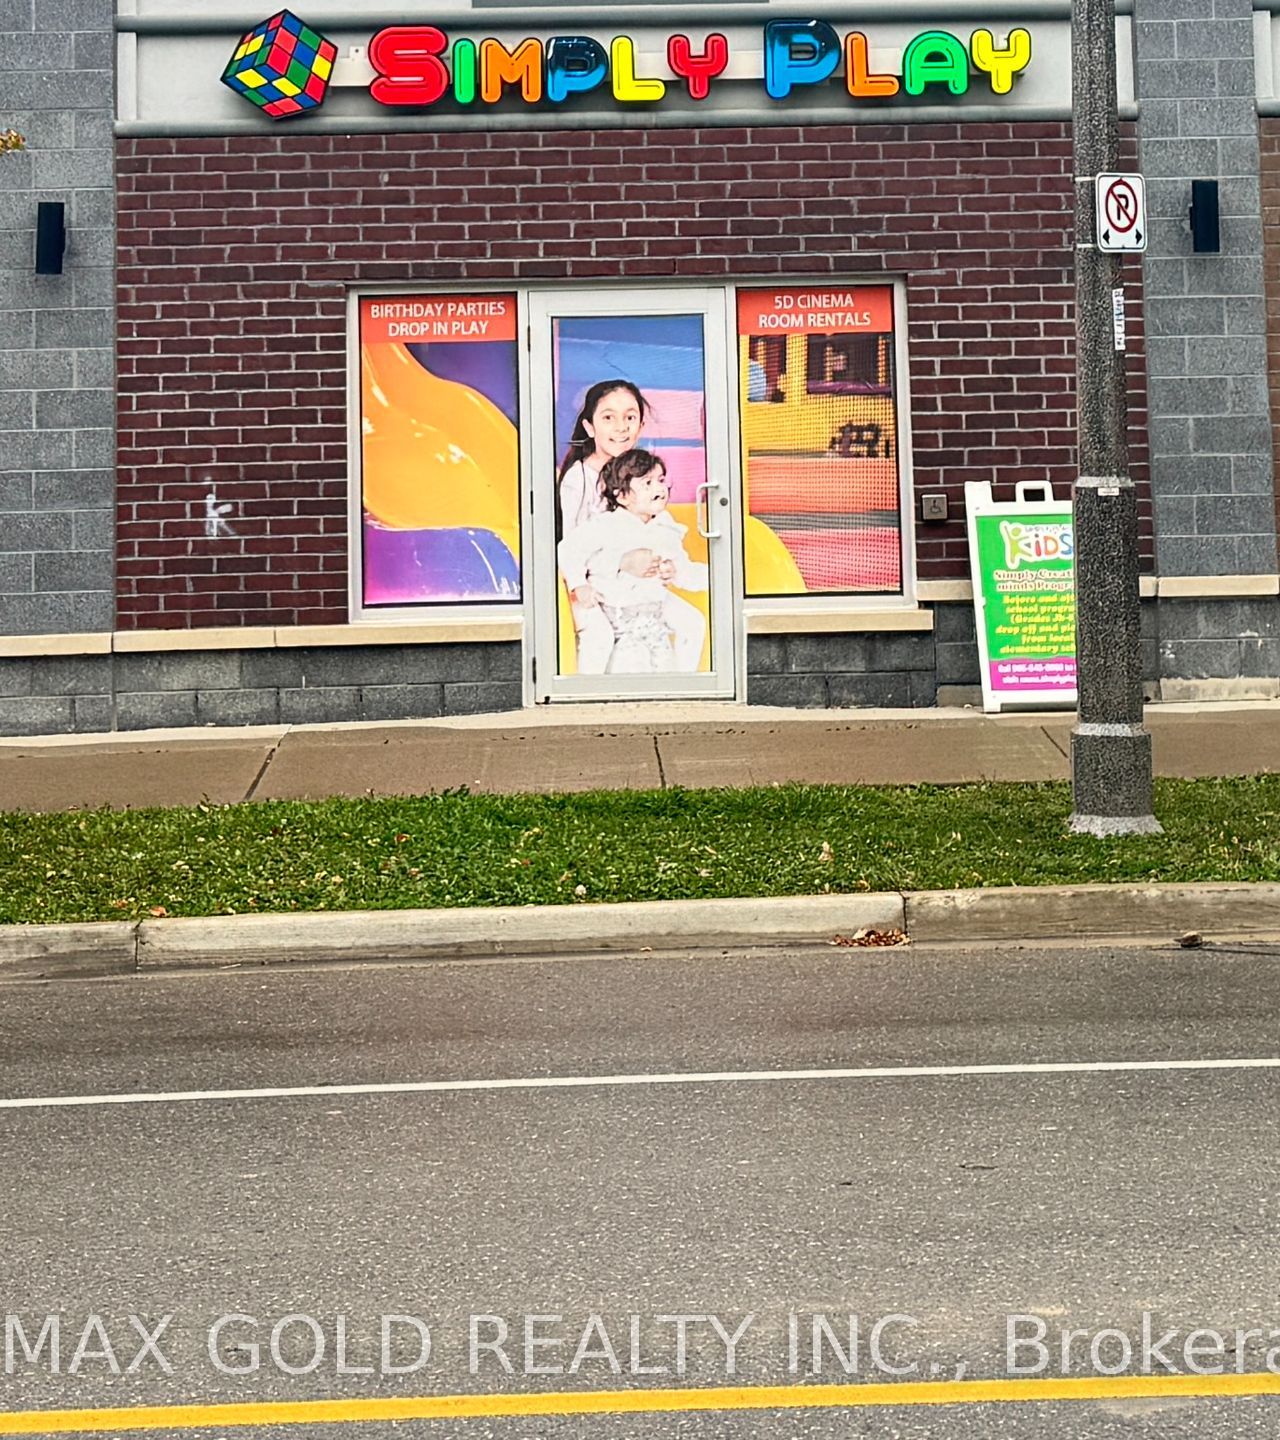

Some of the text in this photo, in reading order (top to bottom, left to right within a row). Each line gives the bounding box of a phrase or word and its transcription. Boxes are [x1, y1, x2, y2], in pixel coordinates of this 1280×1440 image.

[367, 18, 1031, 106] SIMPLY PLAY
[774, 293, 854, 309] 5D CINEMA
[371, 301, 505, 318] BIRTHDAY PARTIES
[758, 312, 871, 328] ROOM RENTALS
[388, 320, 489, 337] DROP IN PLAY
[1039, 570, 1073, 579] Creat
